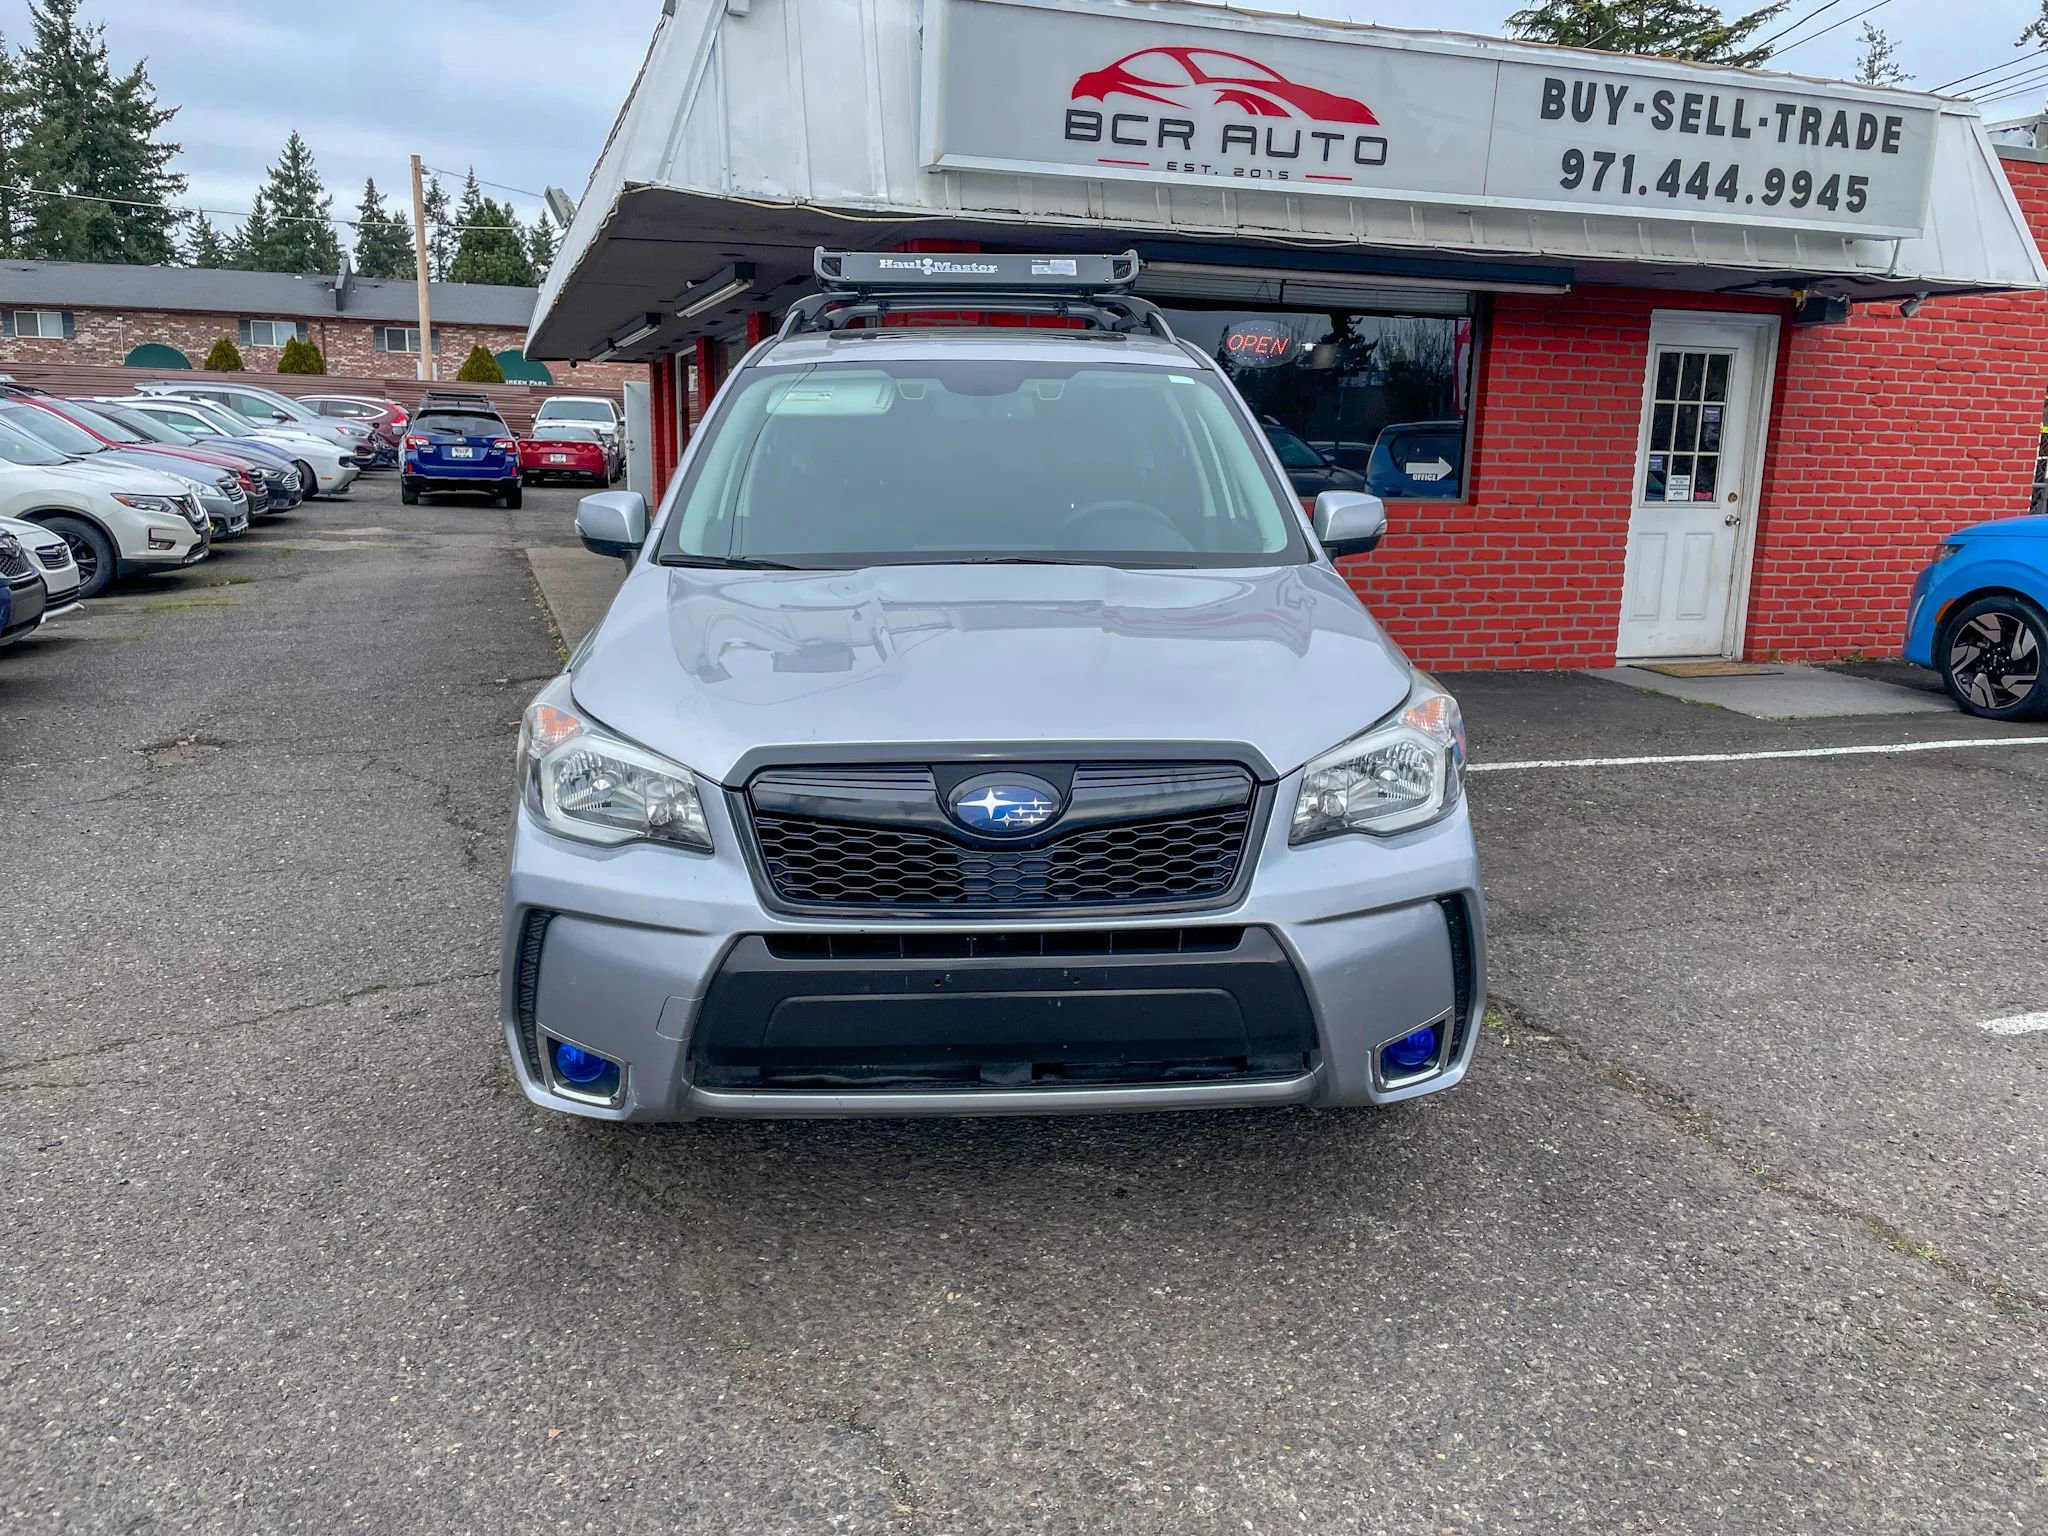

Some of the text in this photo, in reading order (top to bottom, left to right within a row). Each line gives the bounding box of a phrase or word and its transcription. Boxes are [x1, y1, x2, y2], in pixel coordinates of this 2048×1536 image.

[1064, 108, 1389, 166] BCR AUTO
[1166, 160, 1290, 180] EST. 2015
[1559, 148, 1870, 213] 971.444.9945
[879, 259, 922, 269] Haul
[1228, 334, 1289, 355] OPEN
[1412, 473, 1438, 482] OFFICE
